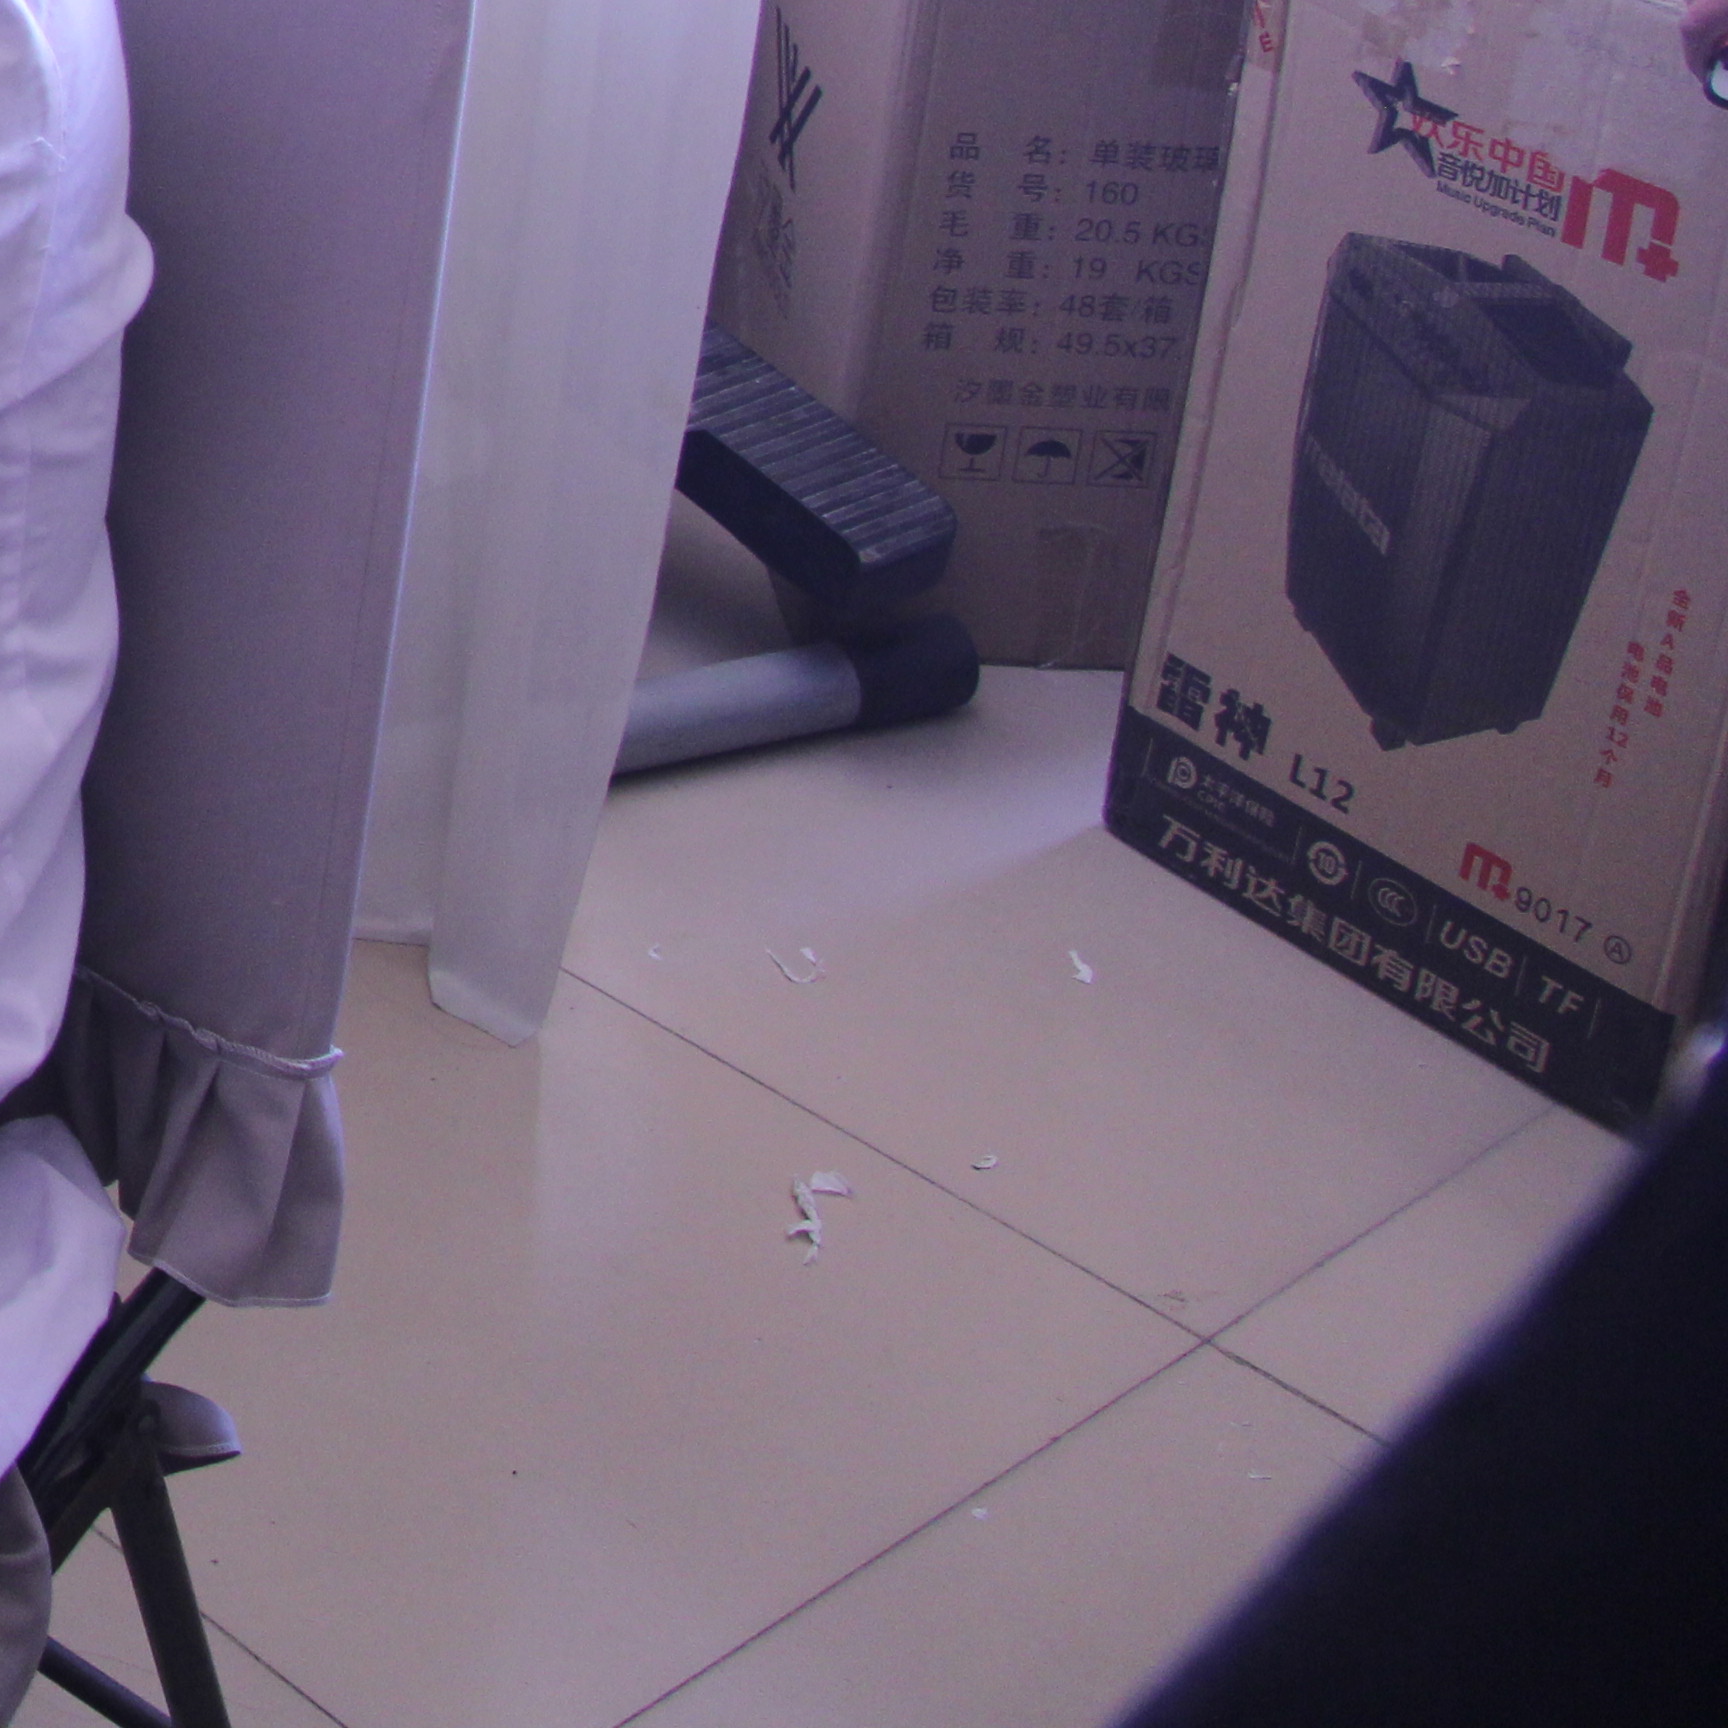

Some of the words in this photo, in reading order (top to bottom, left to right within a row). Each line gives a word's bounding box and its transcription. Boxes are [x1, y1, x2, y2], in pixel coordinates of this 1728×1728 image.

[1411, 113, 1565, 195] 欢乐中国
[1289, 753, 1356, 815] L12
[1157, 813, 1551, 1073] 万利达集团有限公司
[1514, 885, 1593, 941] 9017
[1438, 919, 1516, 980] USB
[1540, 974, 1585, 1015] TF
